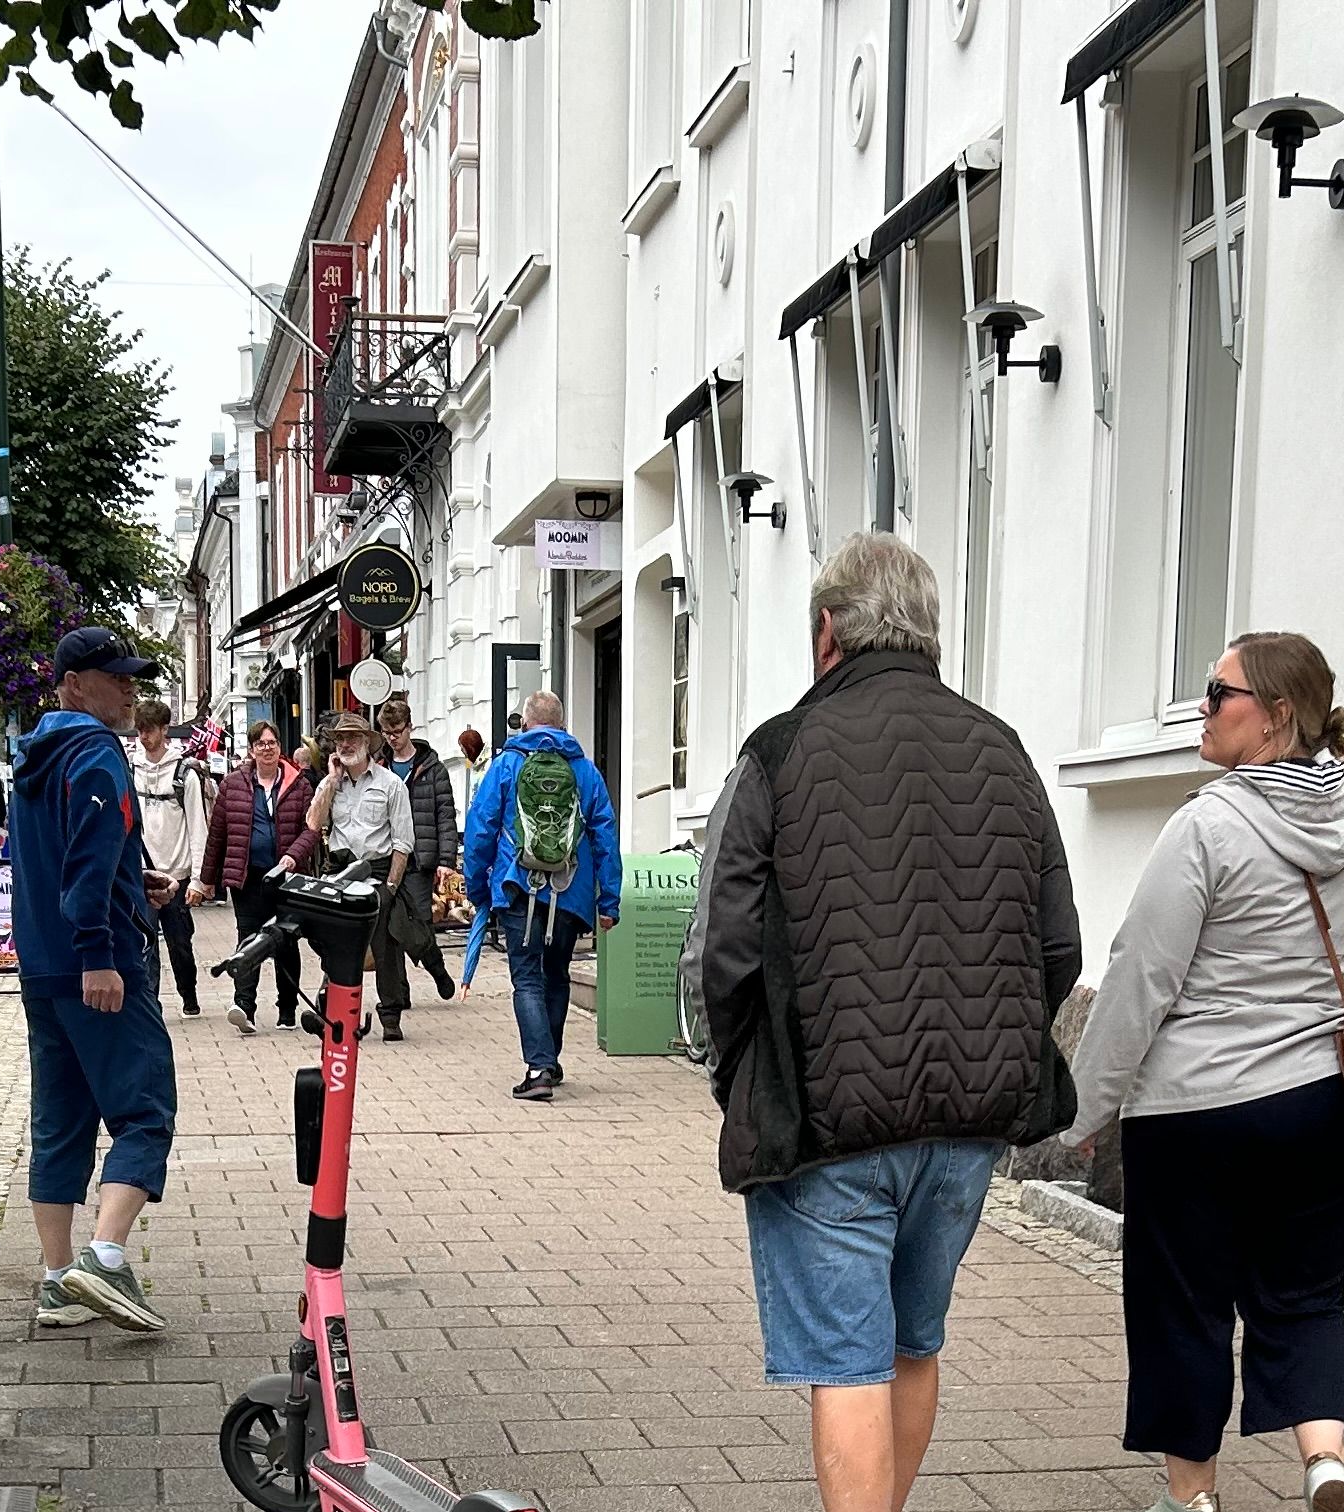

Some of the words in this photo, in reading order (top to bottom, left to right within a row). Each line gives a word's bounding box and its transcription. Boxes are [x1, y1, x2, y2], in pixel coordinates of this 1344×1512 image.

[547, 532, 589, 544] MOOMIN
[362, 581, 398, 594] NORD
[349, 594, 379, 605] Bagels
[359, 678, 386, 688] NORD
